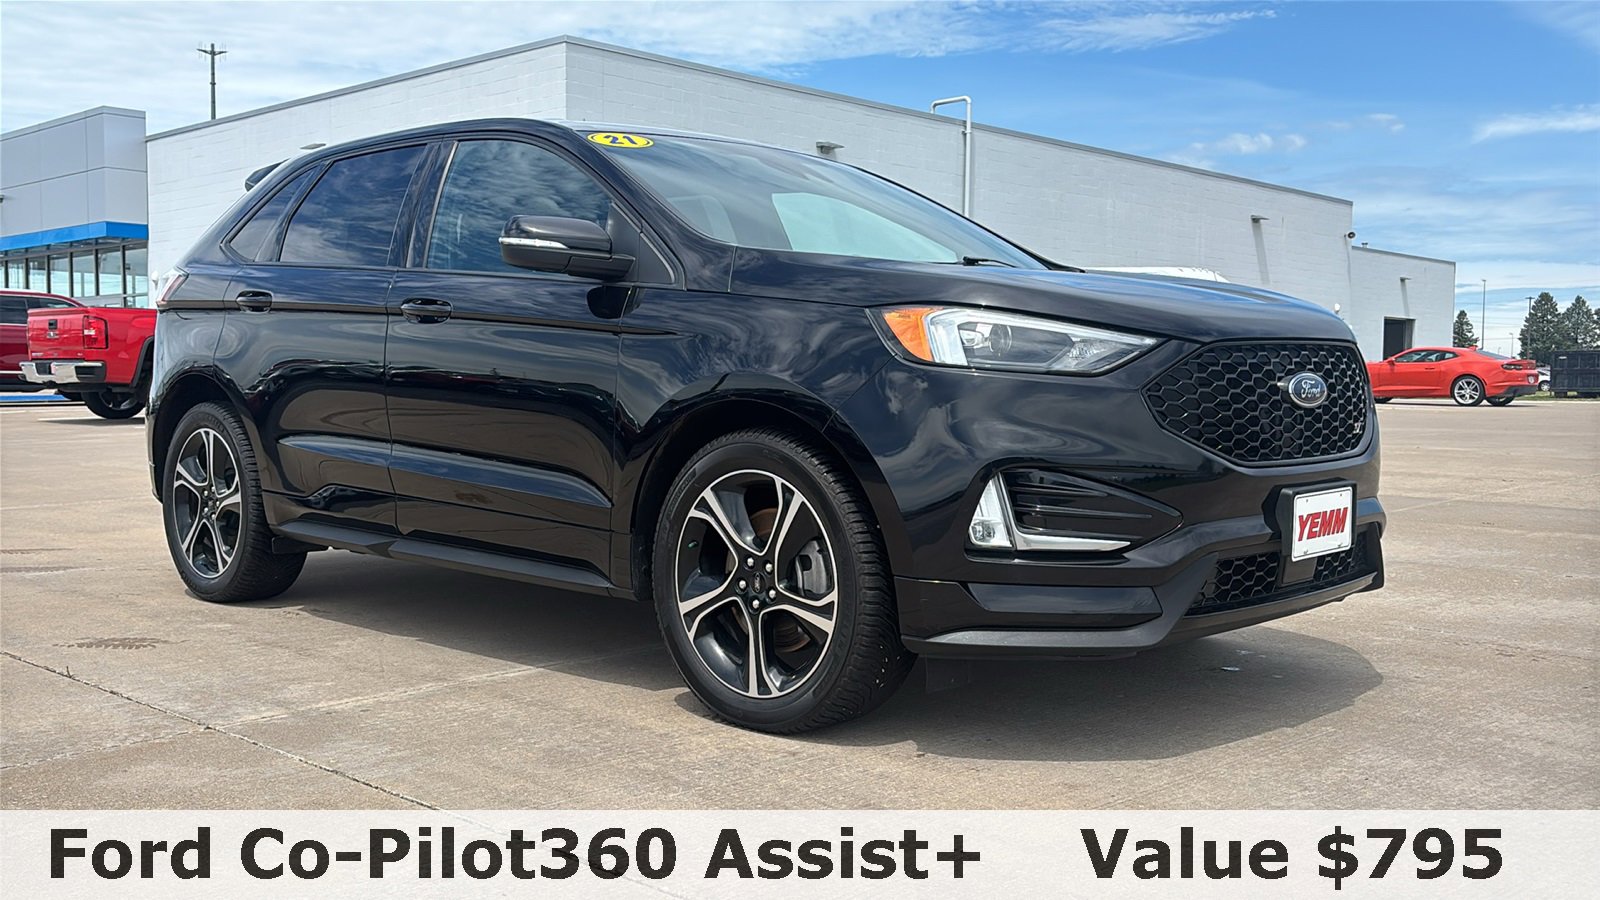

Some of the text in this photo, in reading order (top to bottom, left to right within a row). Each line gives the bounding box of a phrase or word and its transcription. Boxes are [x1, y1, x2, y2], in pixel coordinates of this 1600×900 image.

[603, 134, 638, 146] 21
[1301, 380, 1321, 398] Ford
[1297, 507, 1349, 542] YEMM
